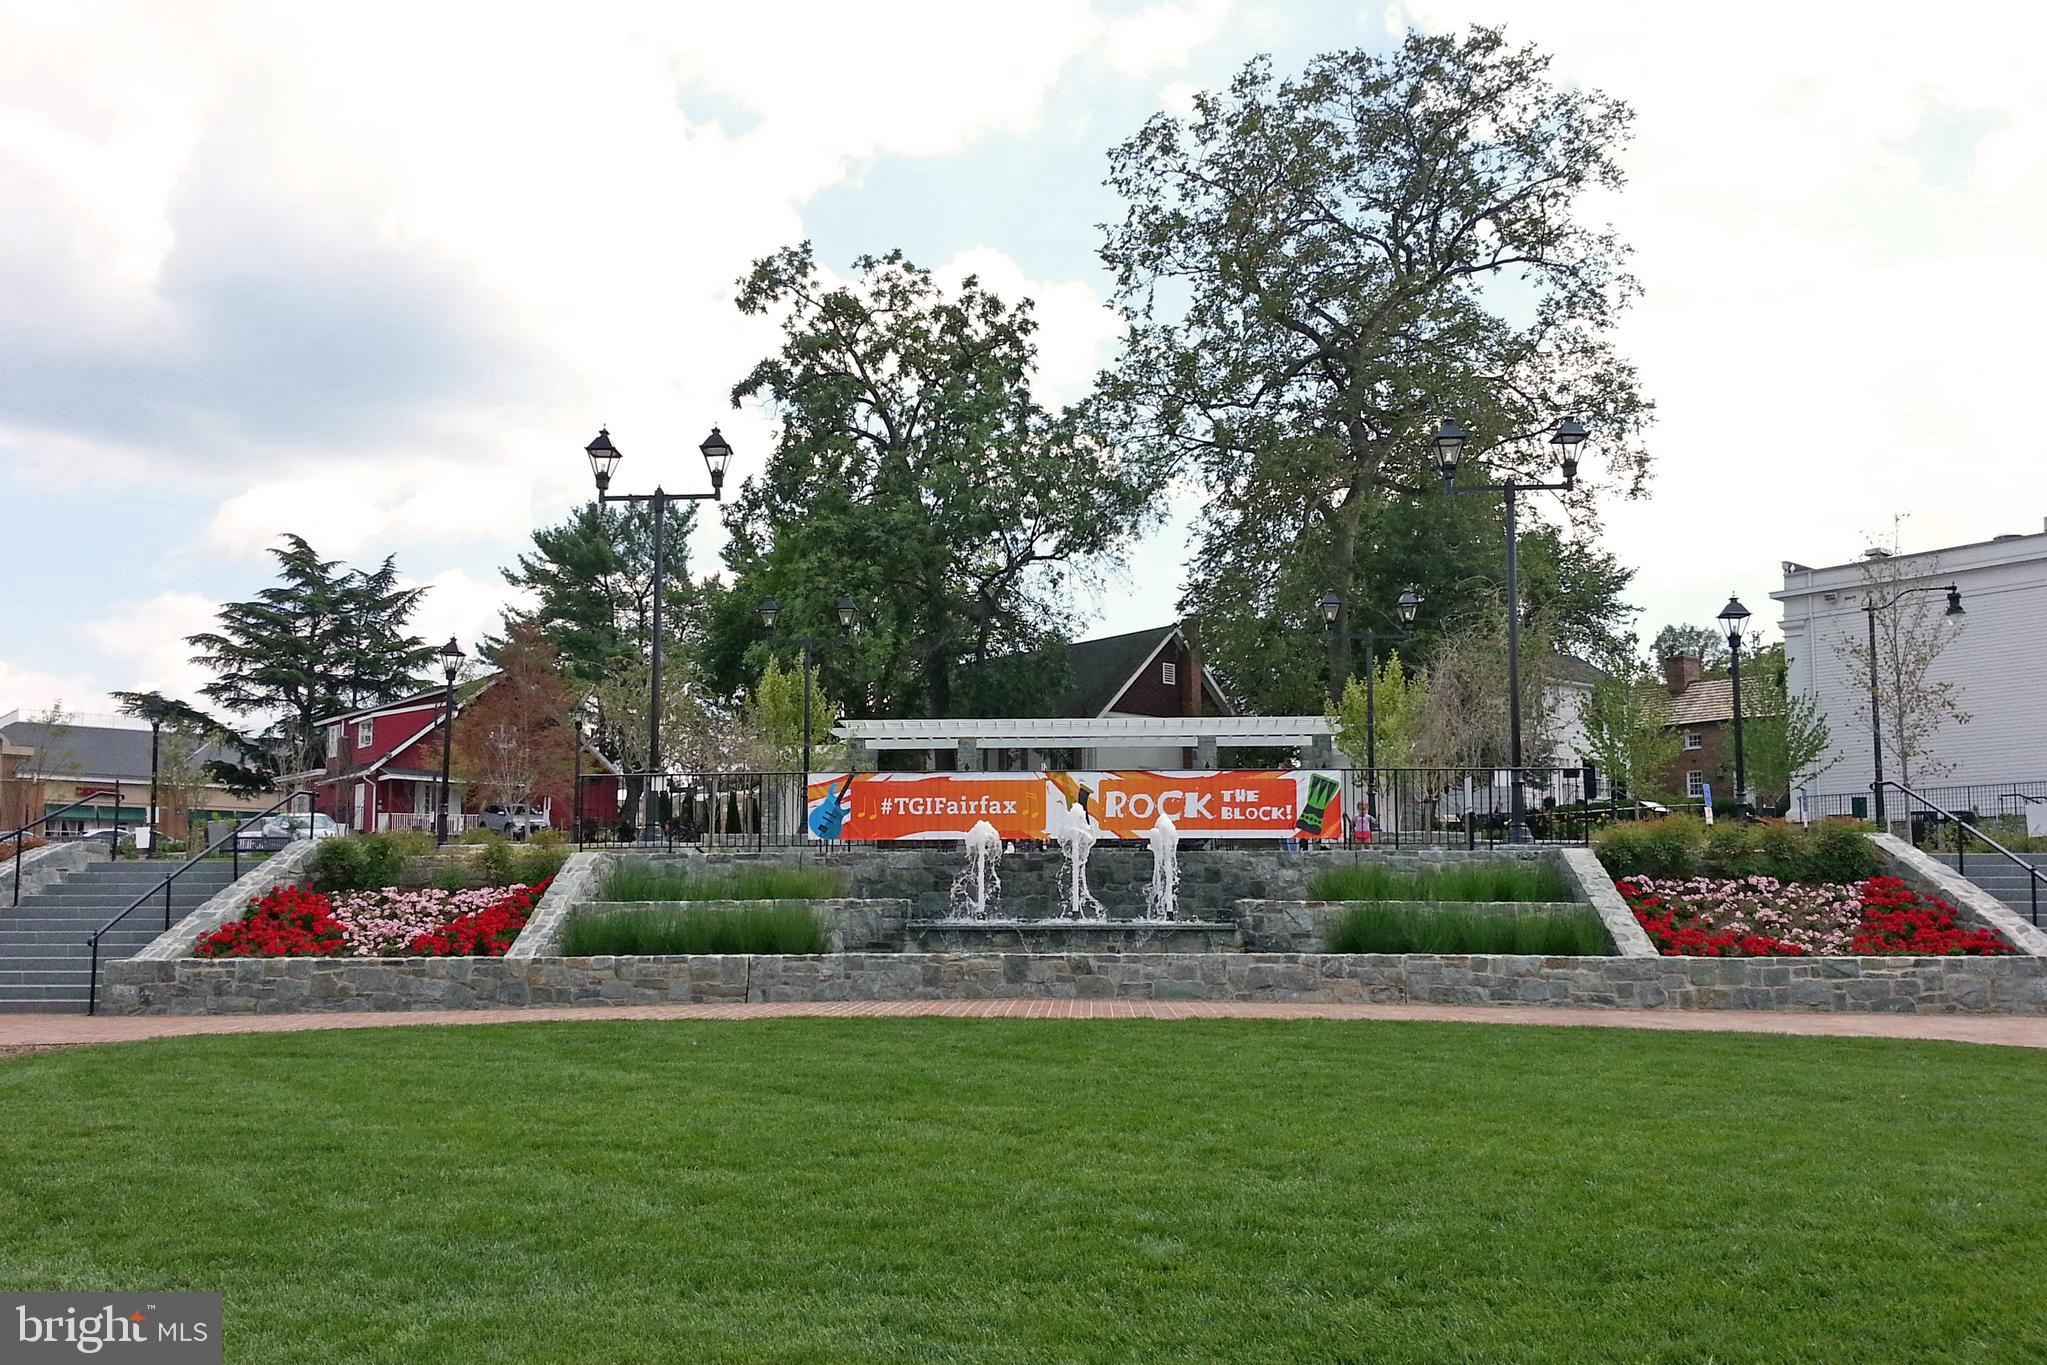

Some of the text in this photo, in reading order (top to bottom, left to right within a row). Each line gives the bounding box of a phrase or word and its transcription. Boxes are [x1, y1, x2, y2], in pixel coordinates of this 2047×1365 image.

[880, 795, 1017, 815] #TGIFairfax
[1221, 789, 1260, 803] THE
[1105, 790, 1214, 821] ROCK
[1221, 805, 1293, 821] BLOCK!
